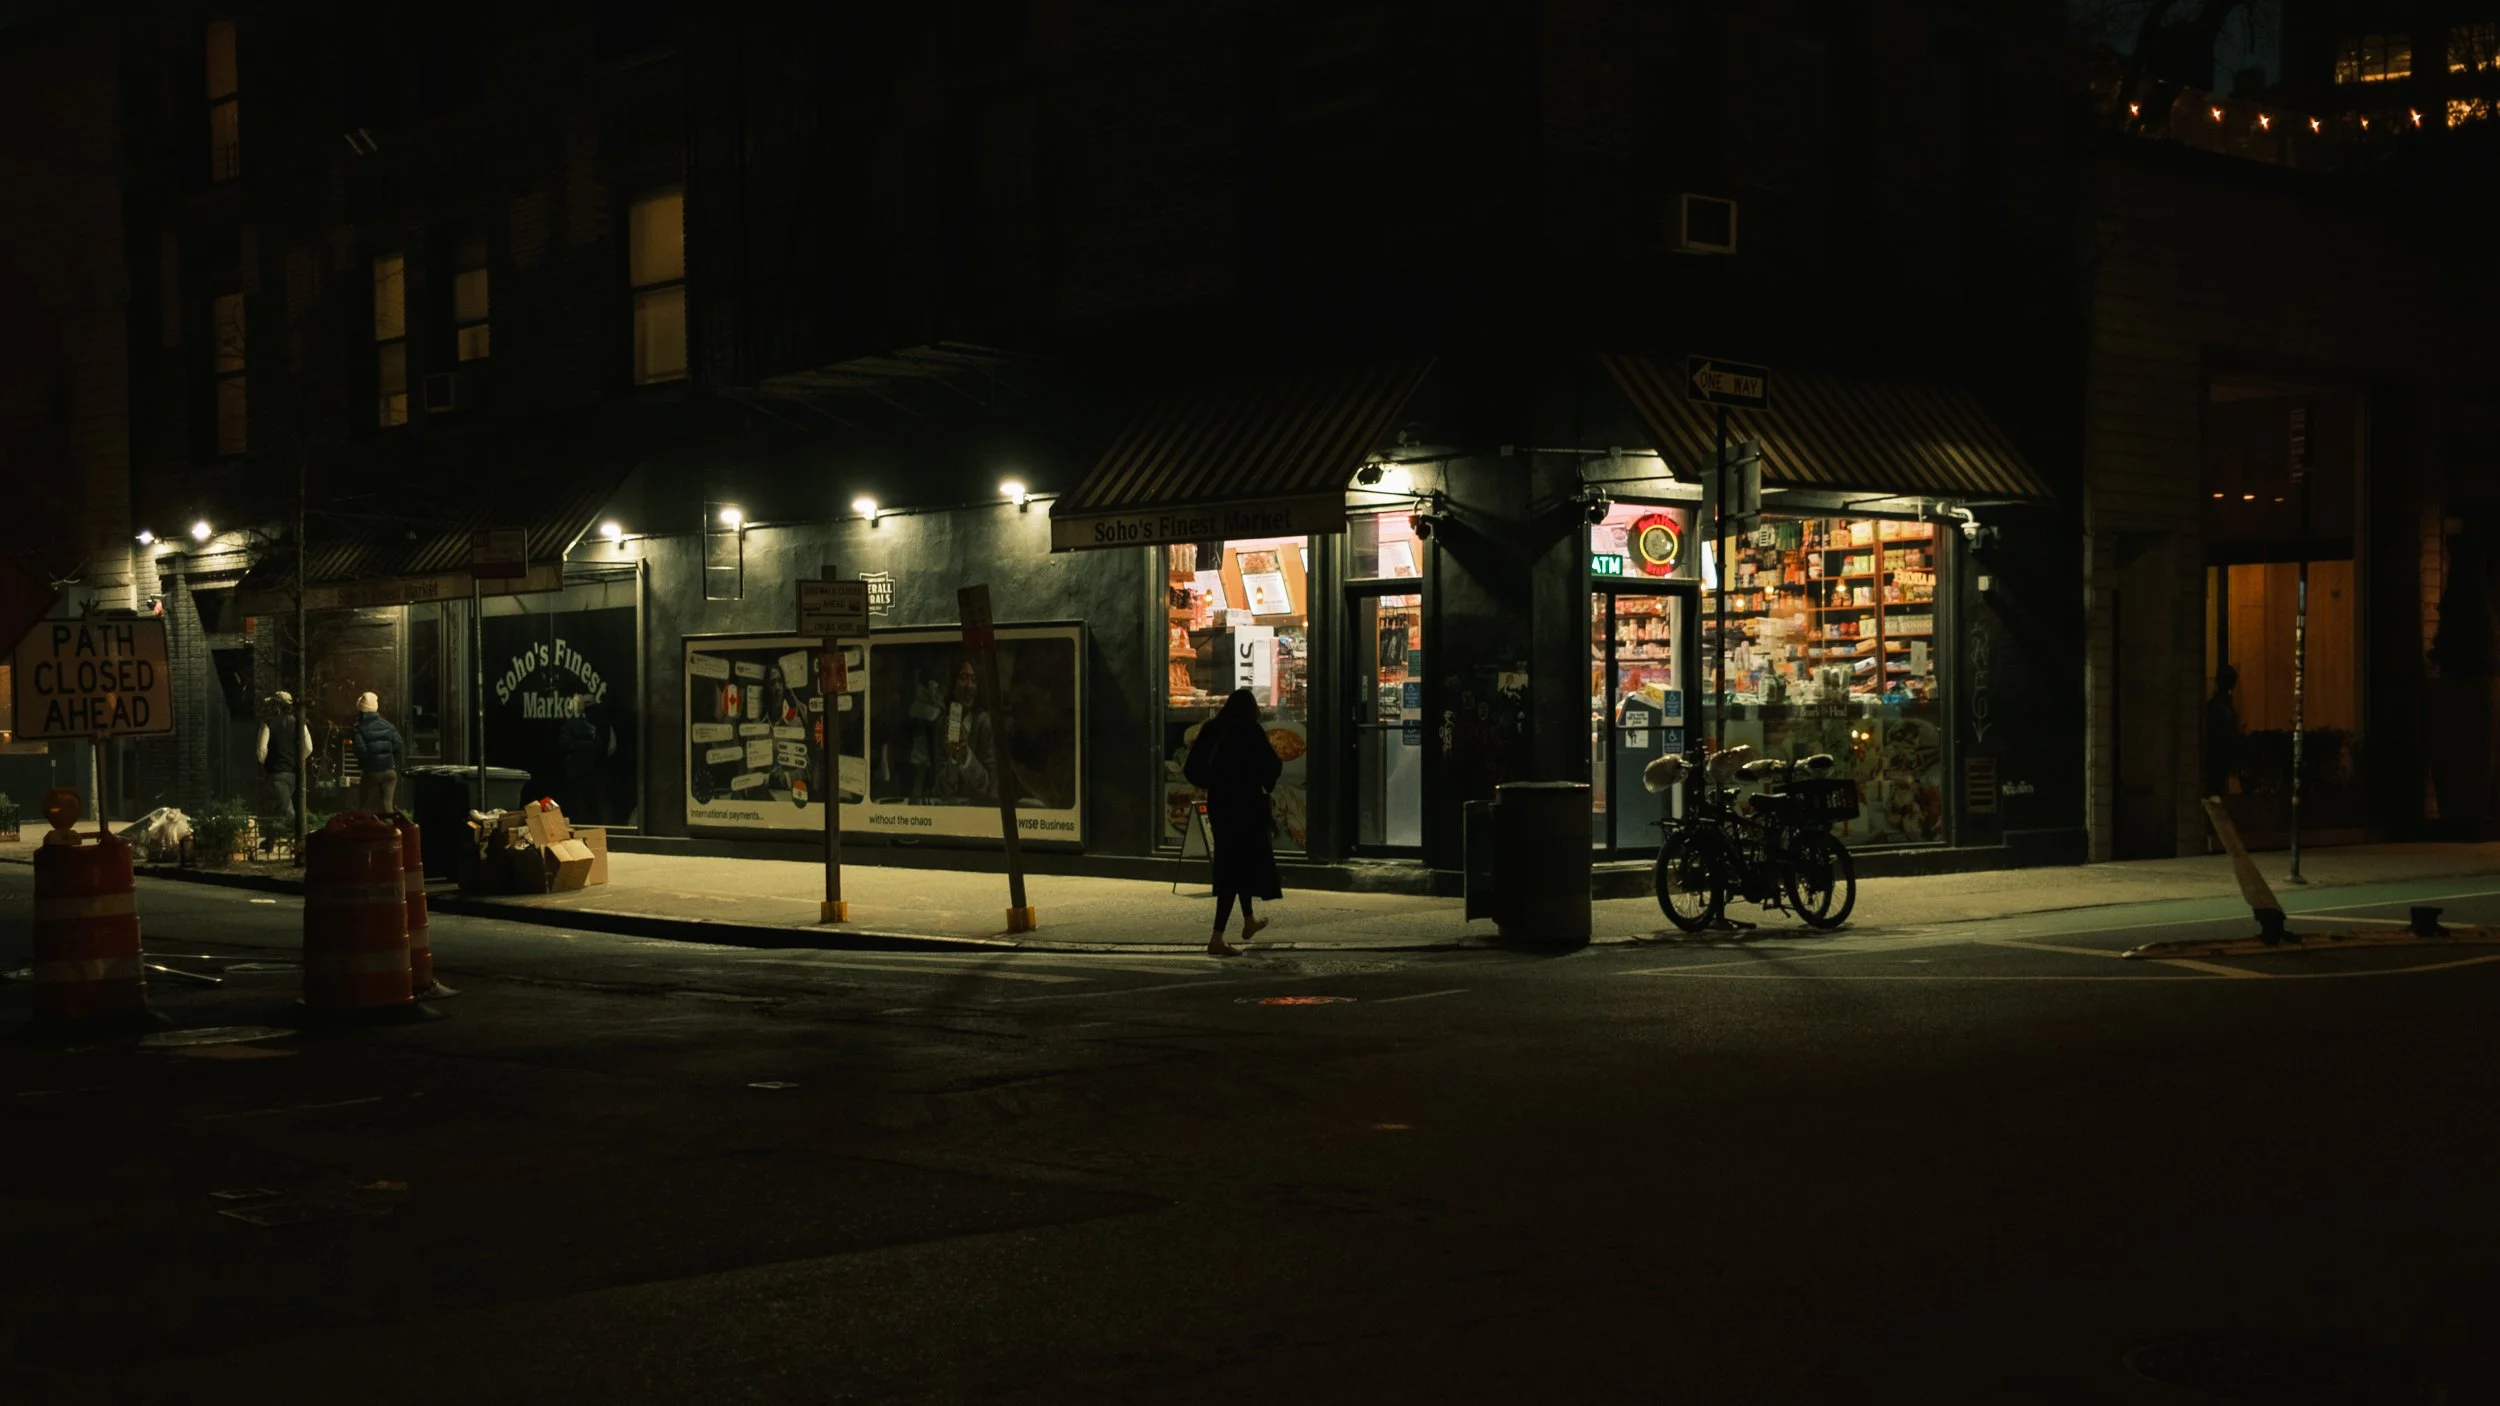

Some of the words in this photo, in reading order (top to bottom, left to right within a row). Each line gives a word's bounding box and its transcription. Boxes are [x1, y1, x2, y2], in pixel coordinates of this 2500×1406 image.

[1701, 371, 1722, 390] ONE
[1735, 377, 1758, 395] WAY
[1094, 519, 1153, 542] Soho's
[1159, 515, 1217, 538] Finest
[1224, 509, 1292, 533] Market
[1592, 556, 1620, 574] ATM
[405, 581, 438, 598] Market
[868, 583, 892, 594] ERALL
[52, 624, 135, 658] PATH
[34, 660, 154, 695] CLOSED
[495, 641, 550, 705] Soho's
[554, 638, 608, 704] Finest
[44, 696, 149, 732] AHEAD
[522, 690, 581, 719] Market
[869, 815, 896, 825] without
[897, 815, 909, 826] the
[910, 815, 933, 826] chaos
[1040, 819, 1075, 831] Business
